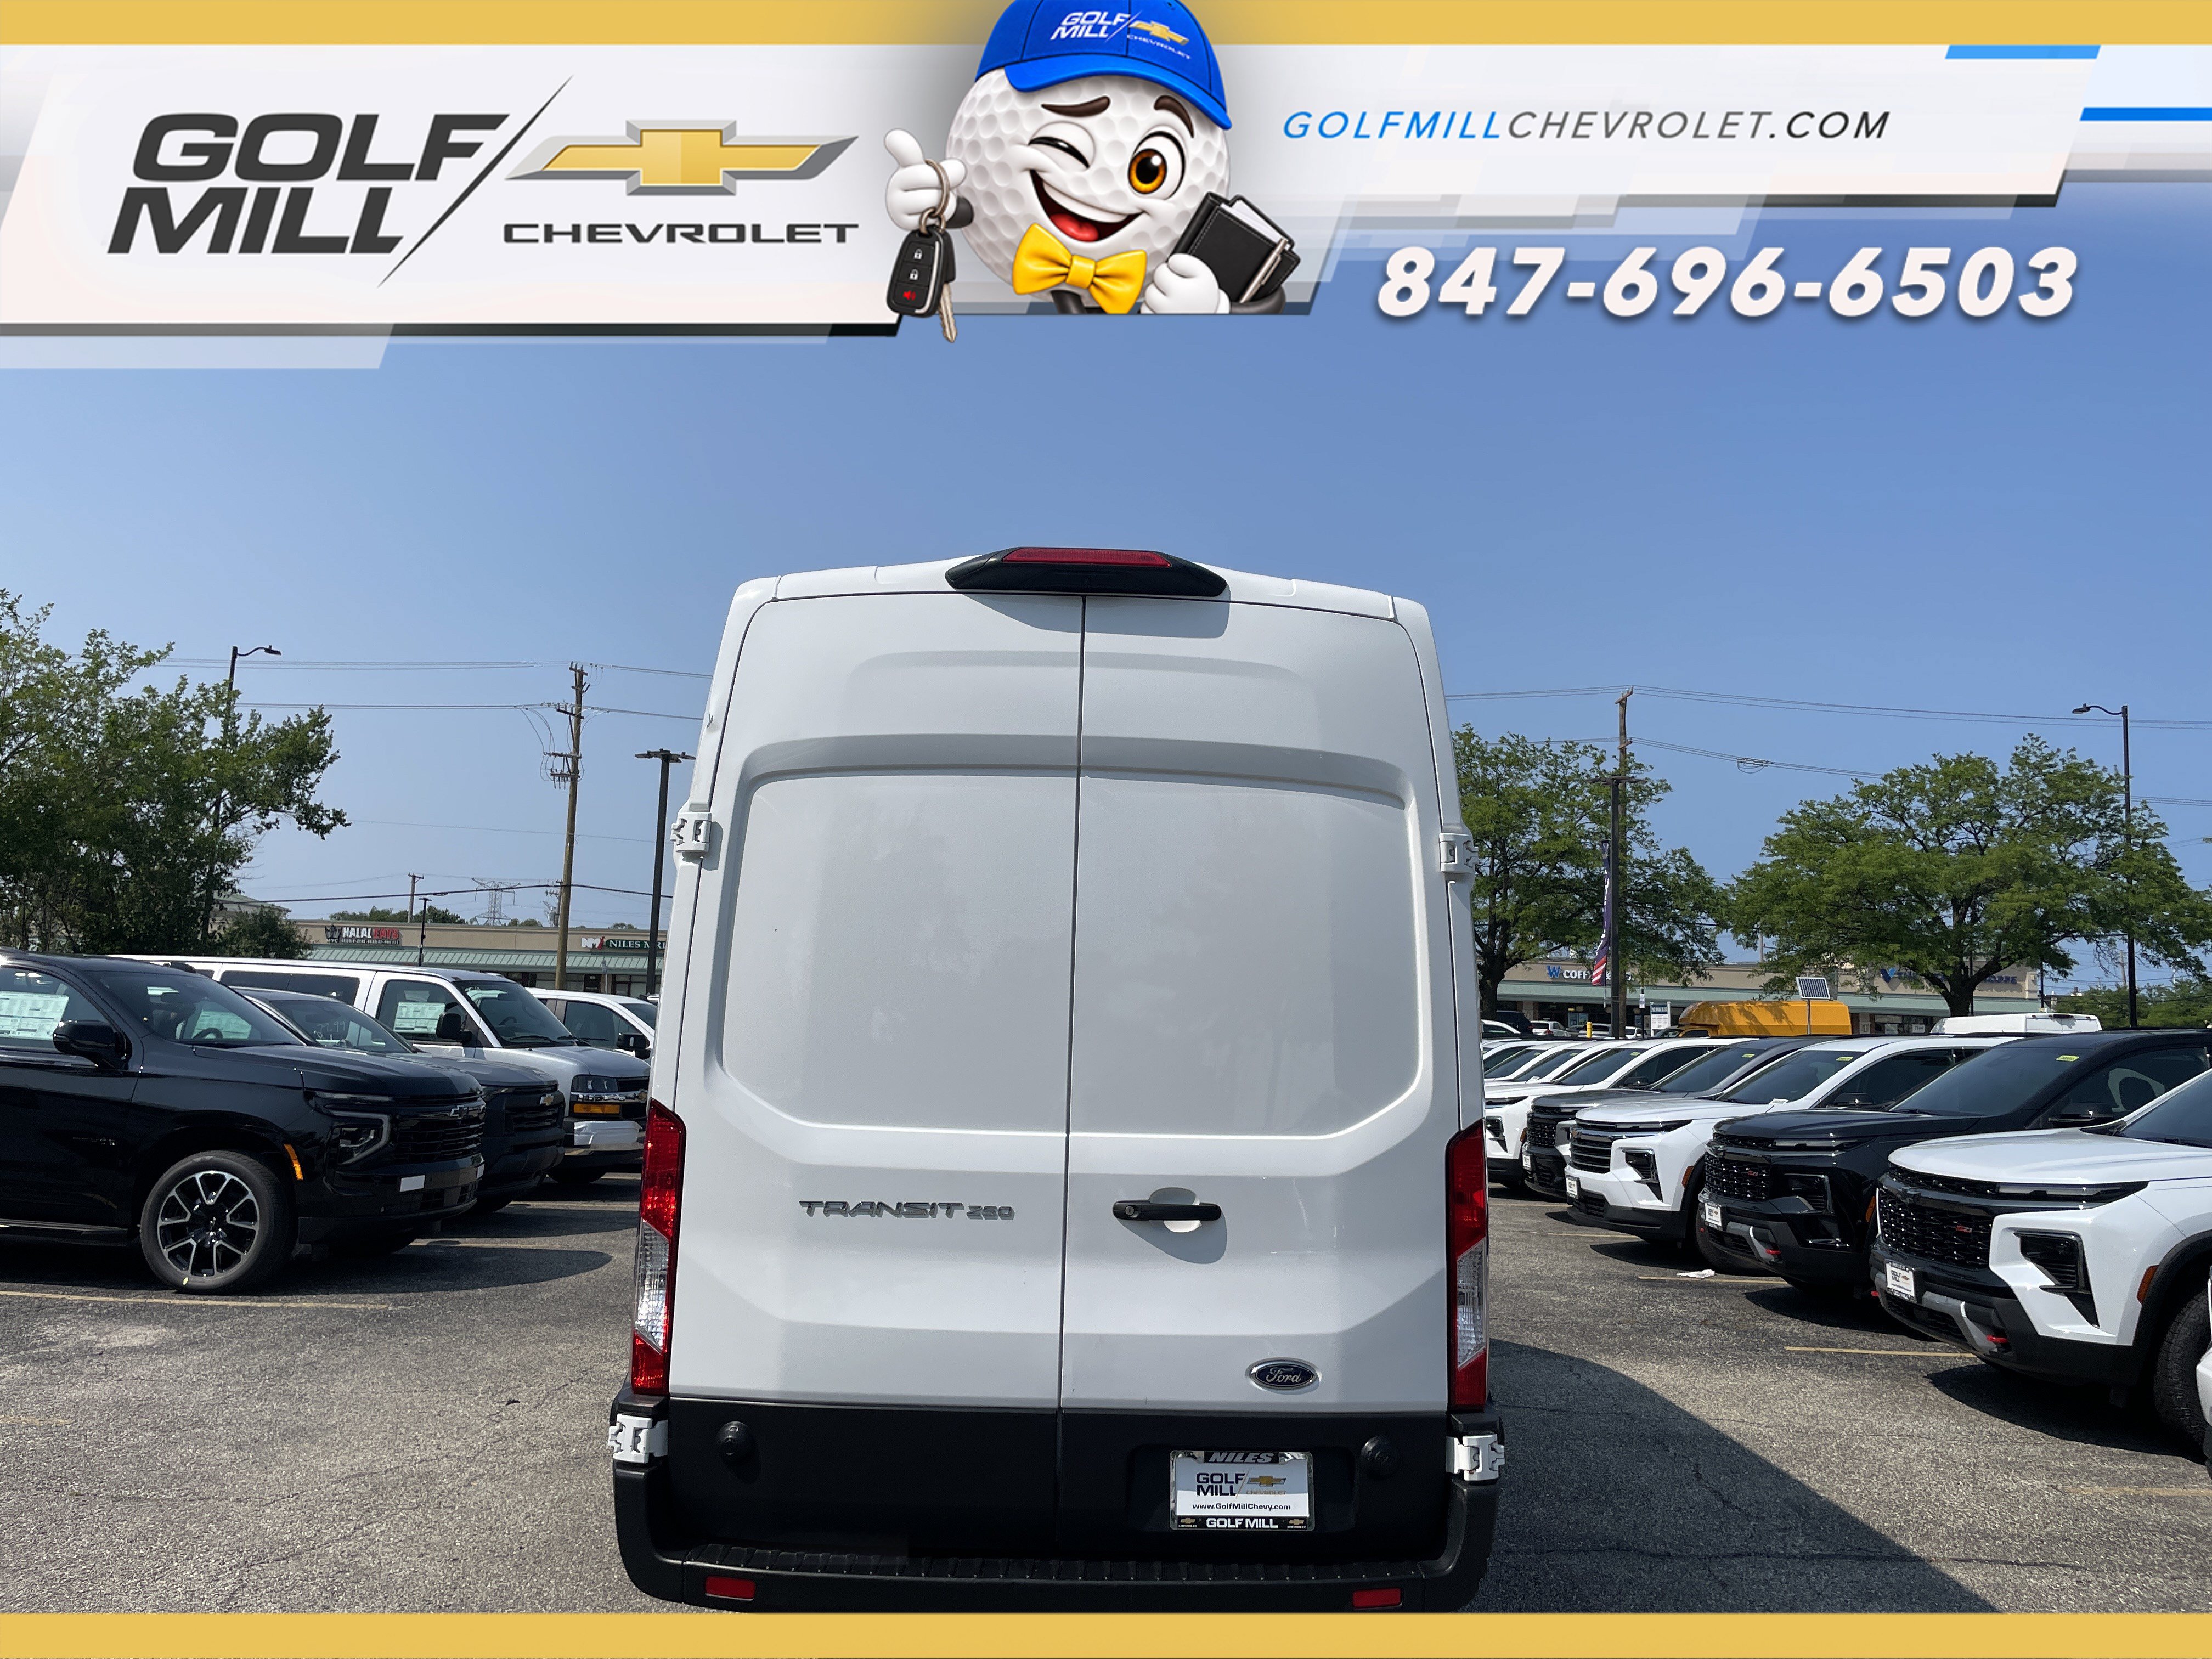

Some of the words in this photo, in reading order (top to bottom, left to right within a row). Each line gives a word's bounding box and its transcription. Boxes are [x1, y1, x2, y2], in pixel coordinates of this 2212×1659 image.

[342, 927, 372, 939] HALAL
[374, 927, 399, 940] EATS
[609, 940, 641, 949] NILES
[799, 1201, 964, 1218] TRANSIT
[966, 1205, 1015, 1220] 250
[1266, 1367, 1301, 1383] Ford
[1209, 1452, 1274, 1464] NILES
[1197, 1472, 1246, 1485] GOLF
[1197, 1485, 1237, 1497] MILL
[1192, 1502, 1291, 1511] www.GolfMillChevy.com
[1206, 1517, 1244, 1528] GOLF
[1245, 1518, 1279, 1529] MILL
